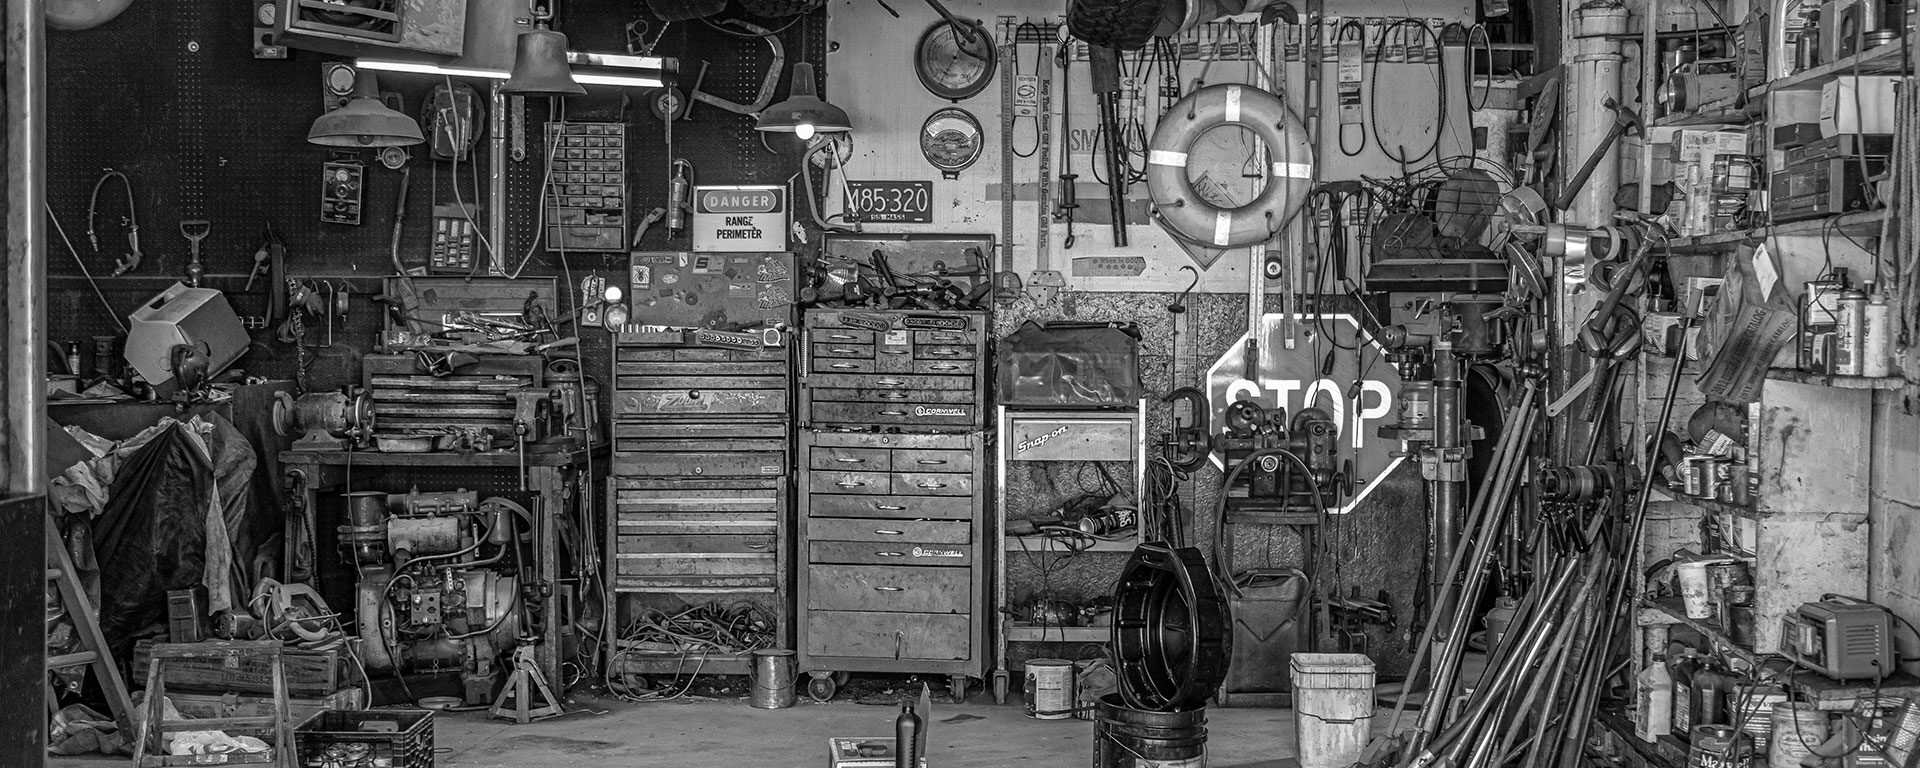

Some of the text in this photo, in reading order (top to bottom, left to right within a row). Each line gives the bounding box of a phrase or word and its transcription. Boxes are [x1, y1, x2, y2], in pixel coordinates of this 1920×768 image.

[1041, 80, 1050, 95] Keep
[1042, 96, 1050, 113] That
[710, 196, 769, 207] DANGER
[726, 216, 754, 226] RANGE
[717, 229, 762, 239] PERIMETER
[926, 408, 966, 416] CORNWELL
[1018, 426, 1069, 454] Snap-on
[1700, 755, 1751, 768] Mawell
